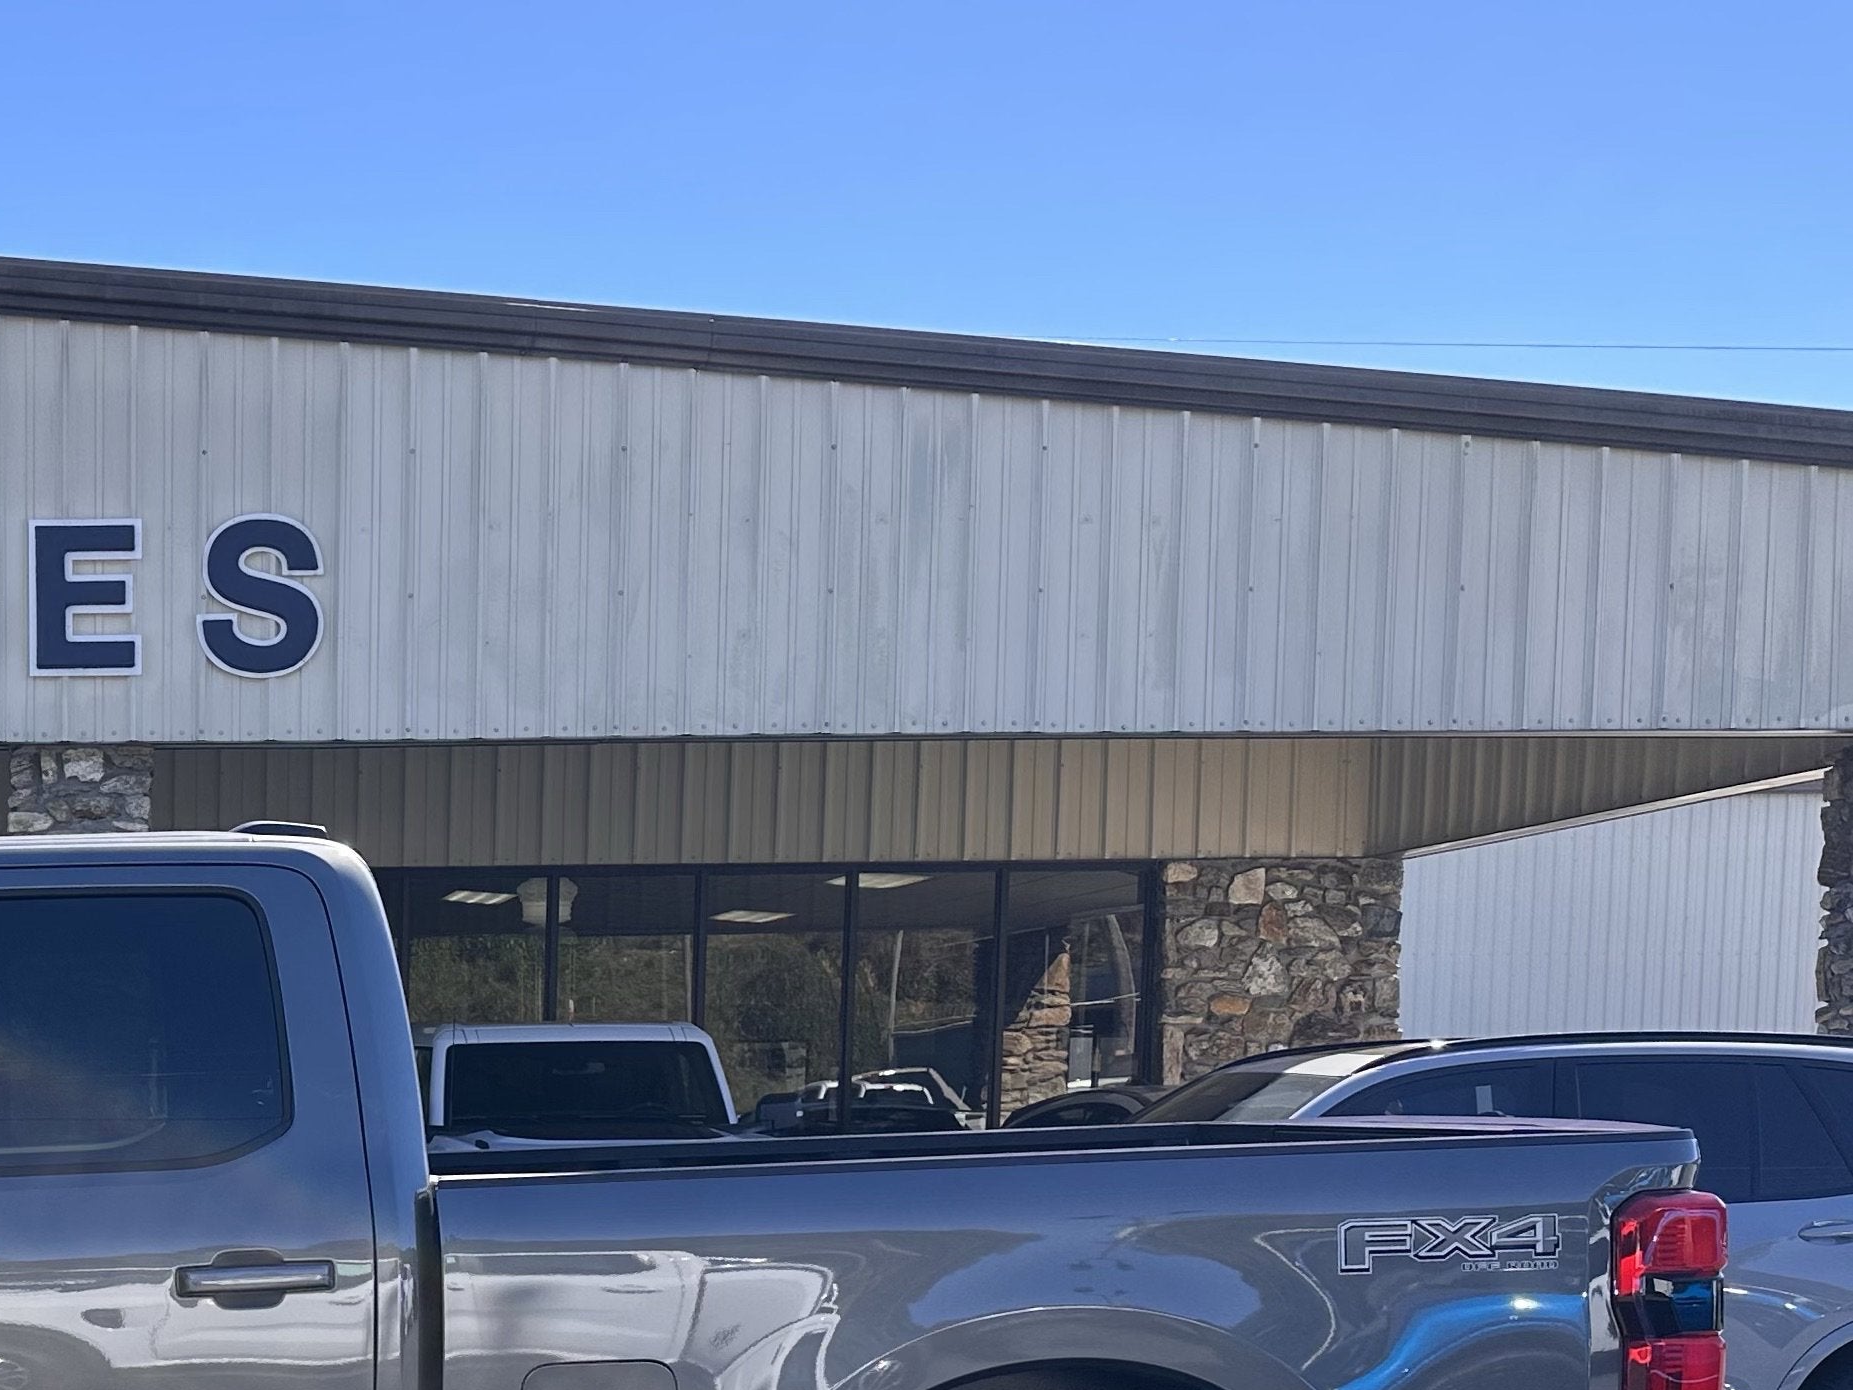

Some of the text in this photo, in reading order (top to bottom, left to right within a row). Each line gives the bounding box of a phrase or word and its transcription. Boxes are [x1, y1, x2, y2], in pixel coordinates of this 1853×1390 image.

[1338, 1213, 1562, 1275] FX4
[1460, 1260, 1559, 1272] OFF ROAD
